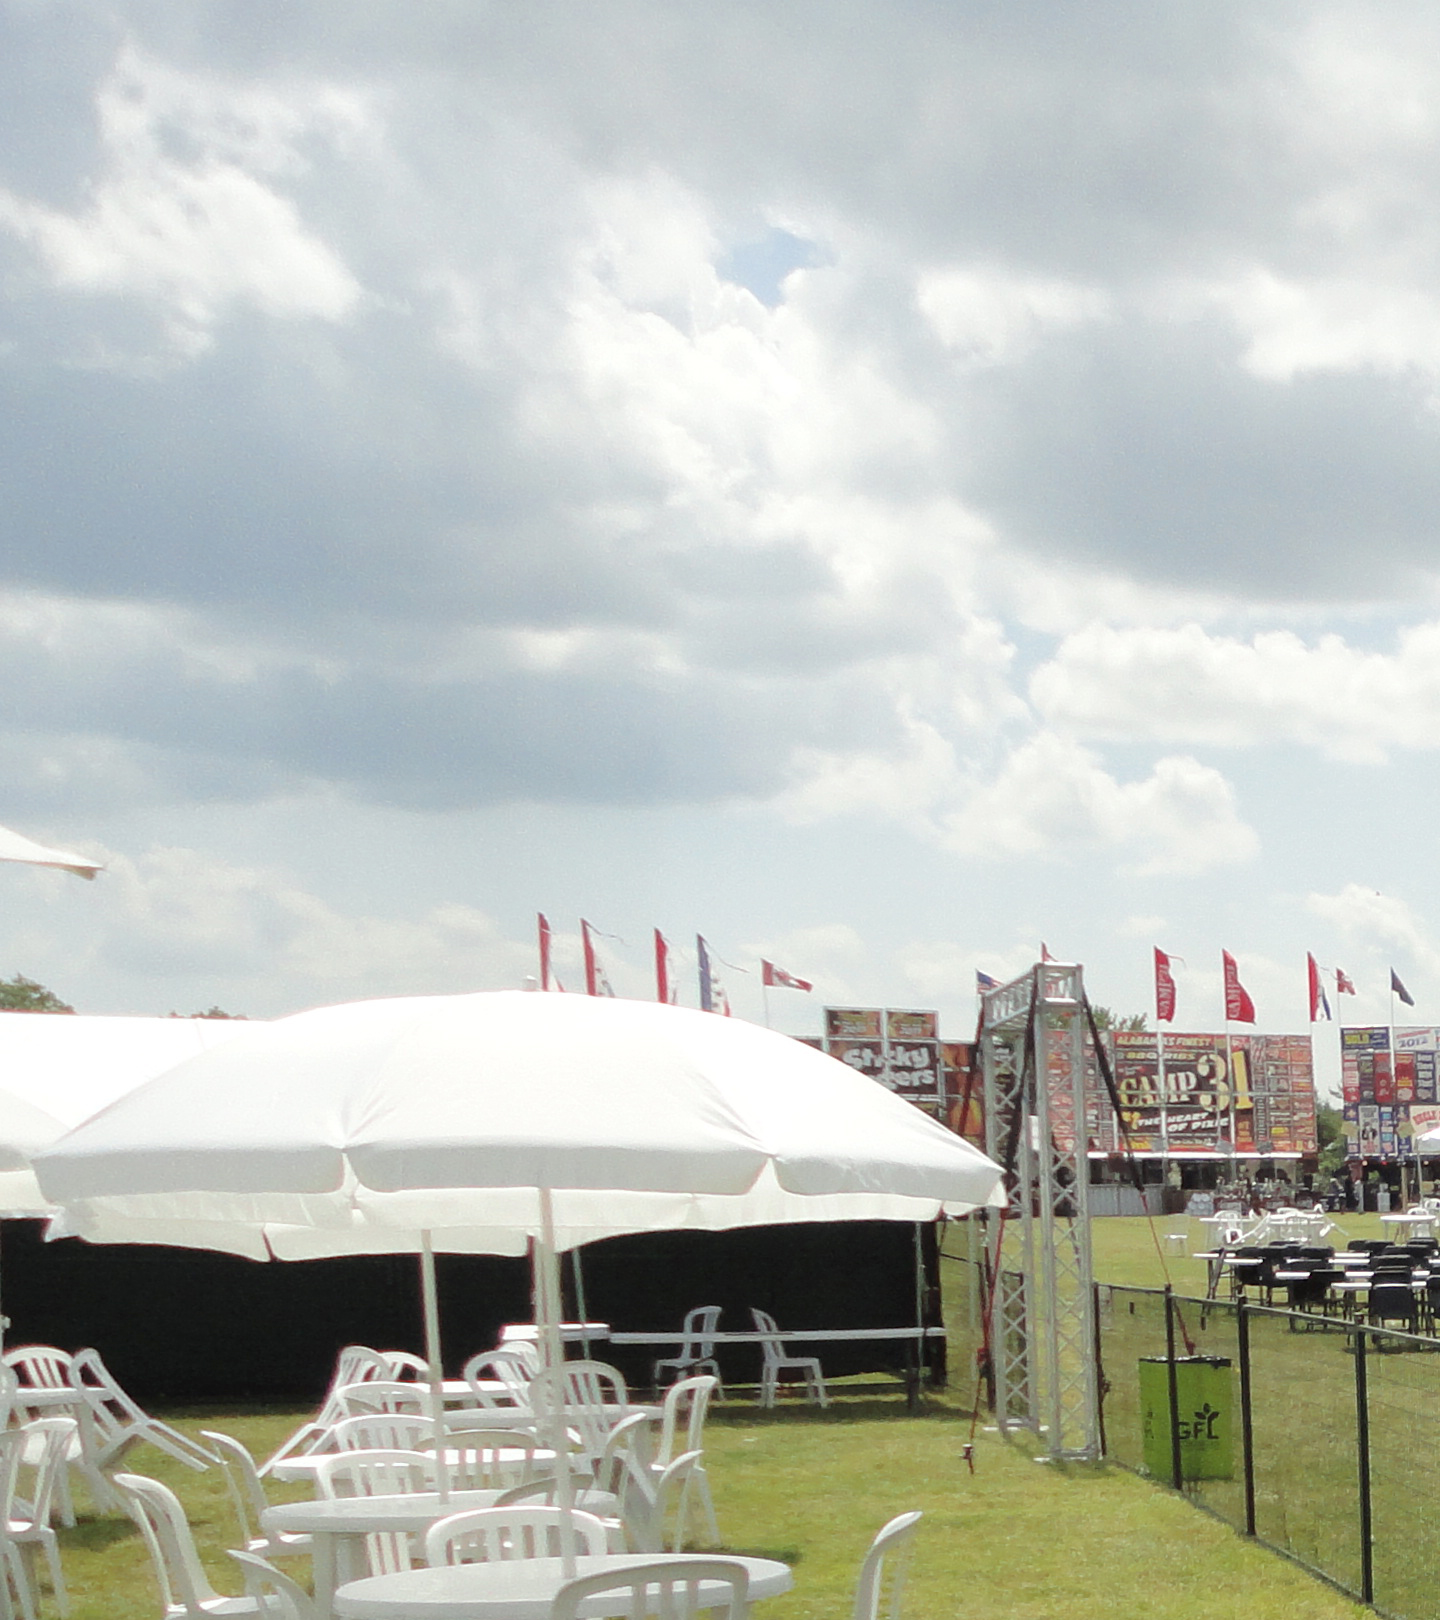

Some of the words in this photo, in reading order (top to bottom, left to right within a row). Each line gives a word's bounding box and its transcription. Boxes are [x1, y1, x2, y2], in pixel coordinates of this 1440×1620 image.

[1120, 1071, 1197, 1108] CAMP
[1197, 1050, 1254, 1112] 31
[1178, 1411, 1220, 1440] GFL
